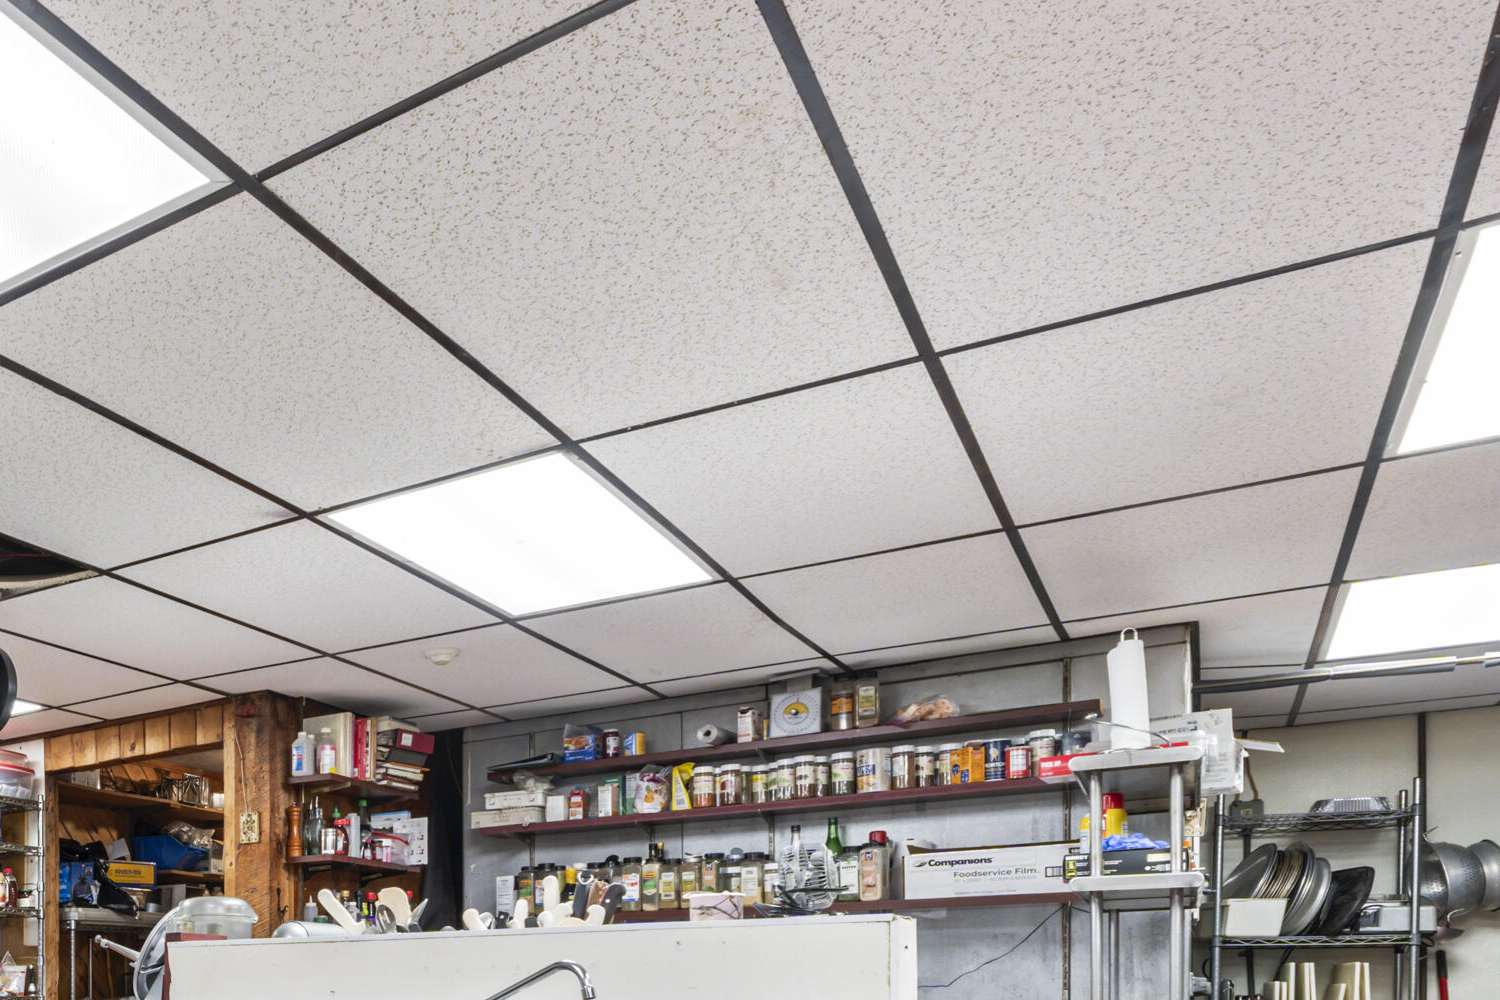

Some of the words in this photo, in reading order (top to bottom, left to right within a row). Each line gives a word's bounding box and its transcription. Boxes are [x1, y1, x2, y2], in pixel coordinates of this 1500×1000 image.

[927, 856, 993, 868] Companions
[953, 869, 1012, 878] Foodservice
[1014, 866, 1037, 875] Film
